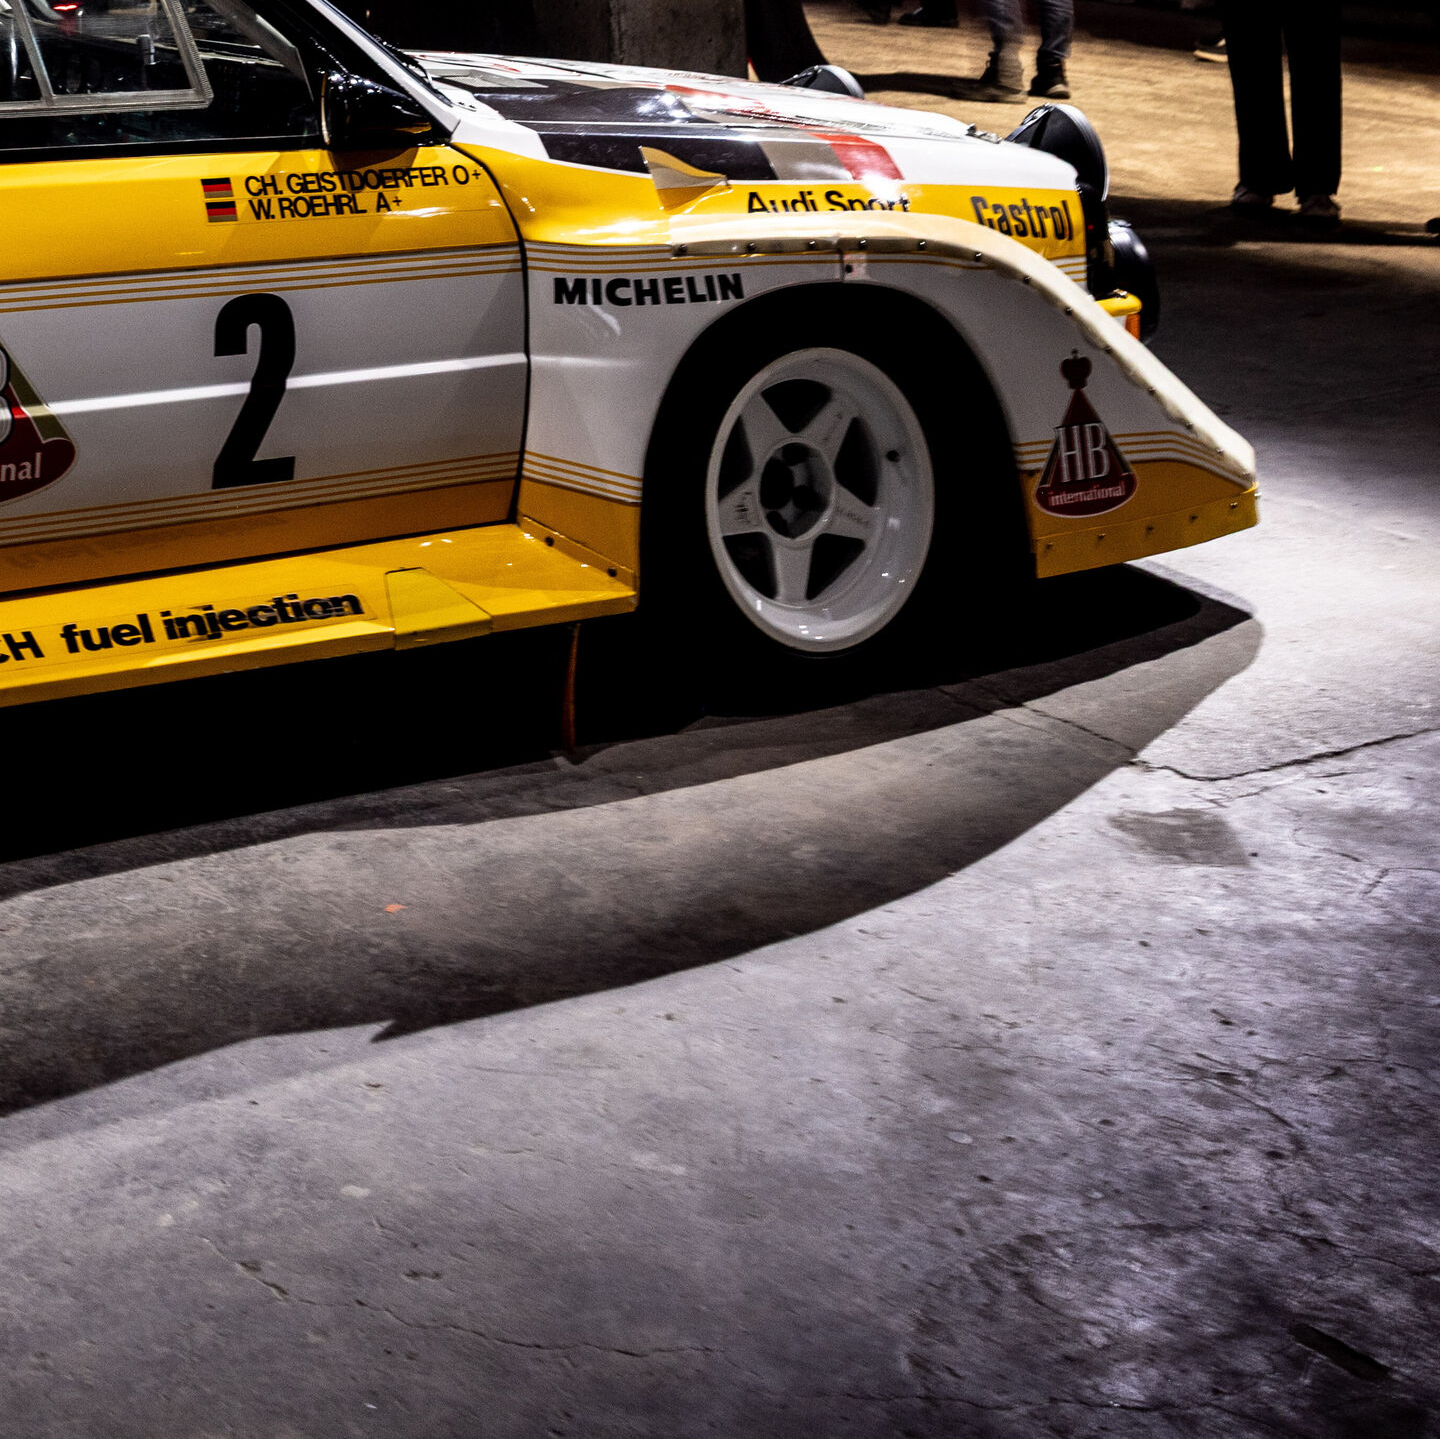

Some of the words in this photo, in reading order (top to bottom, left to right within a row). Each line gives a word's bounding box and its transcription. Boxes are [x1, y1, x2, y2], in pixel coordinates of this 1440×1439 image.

[244, 174, 284, 197] CH.
[286, 166, 449, 194] GEISTDOERFER
[248, 198, 275, 221] W.
[280, 192, 367, 220] ROEHRL
[746, 189, 817, 214] Audi
[969, 194, 1075, 242] Castrol
[553, 272, 746, 307] MICHELIN
[211, 292, 296, 490] 2
[1053, 421, 1110, 484] HB
[1048, 480, 1126, 508] international
[60, 612, 157, 655] fuel
[162, 589, 365, 643] injection
